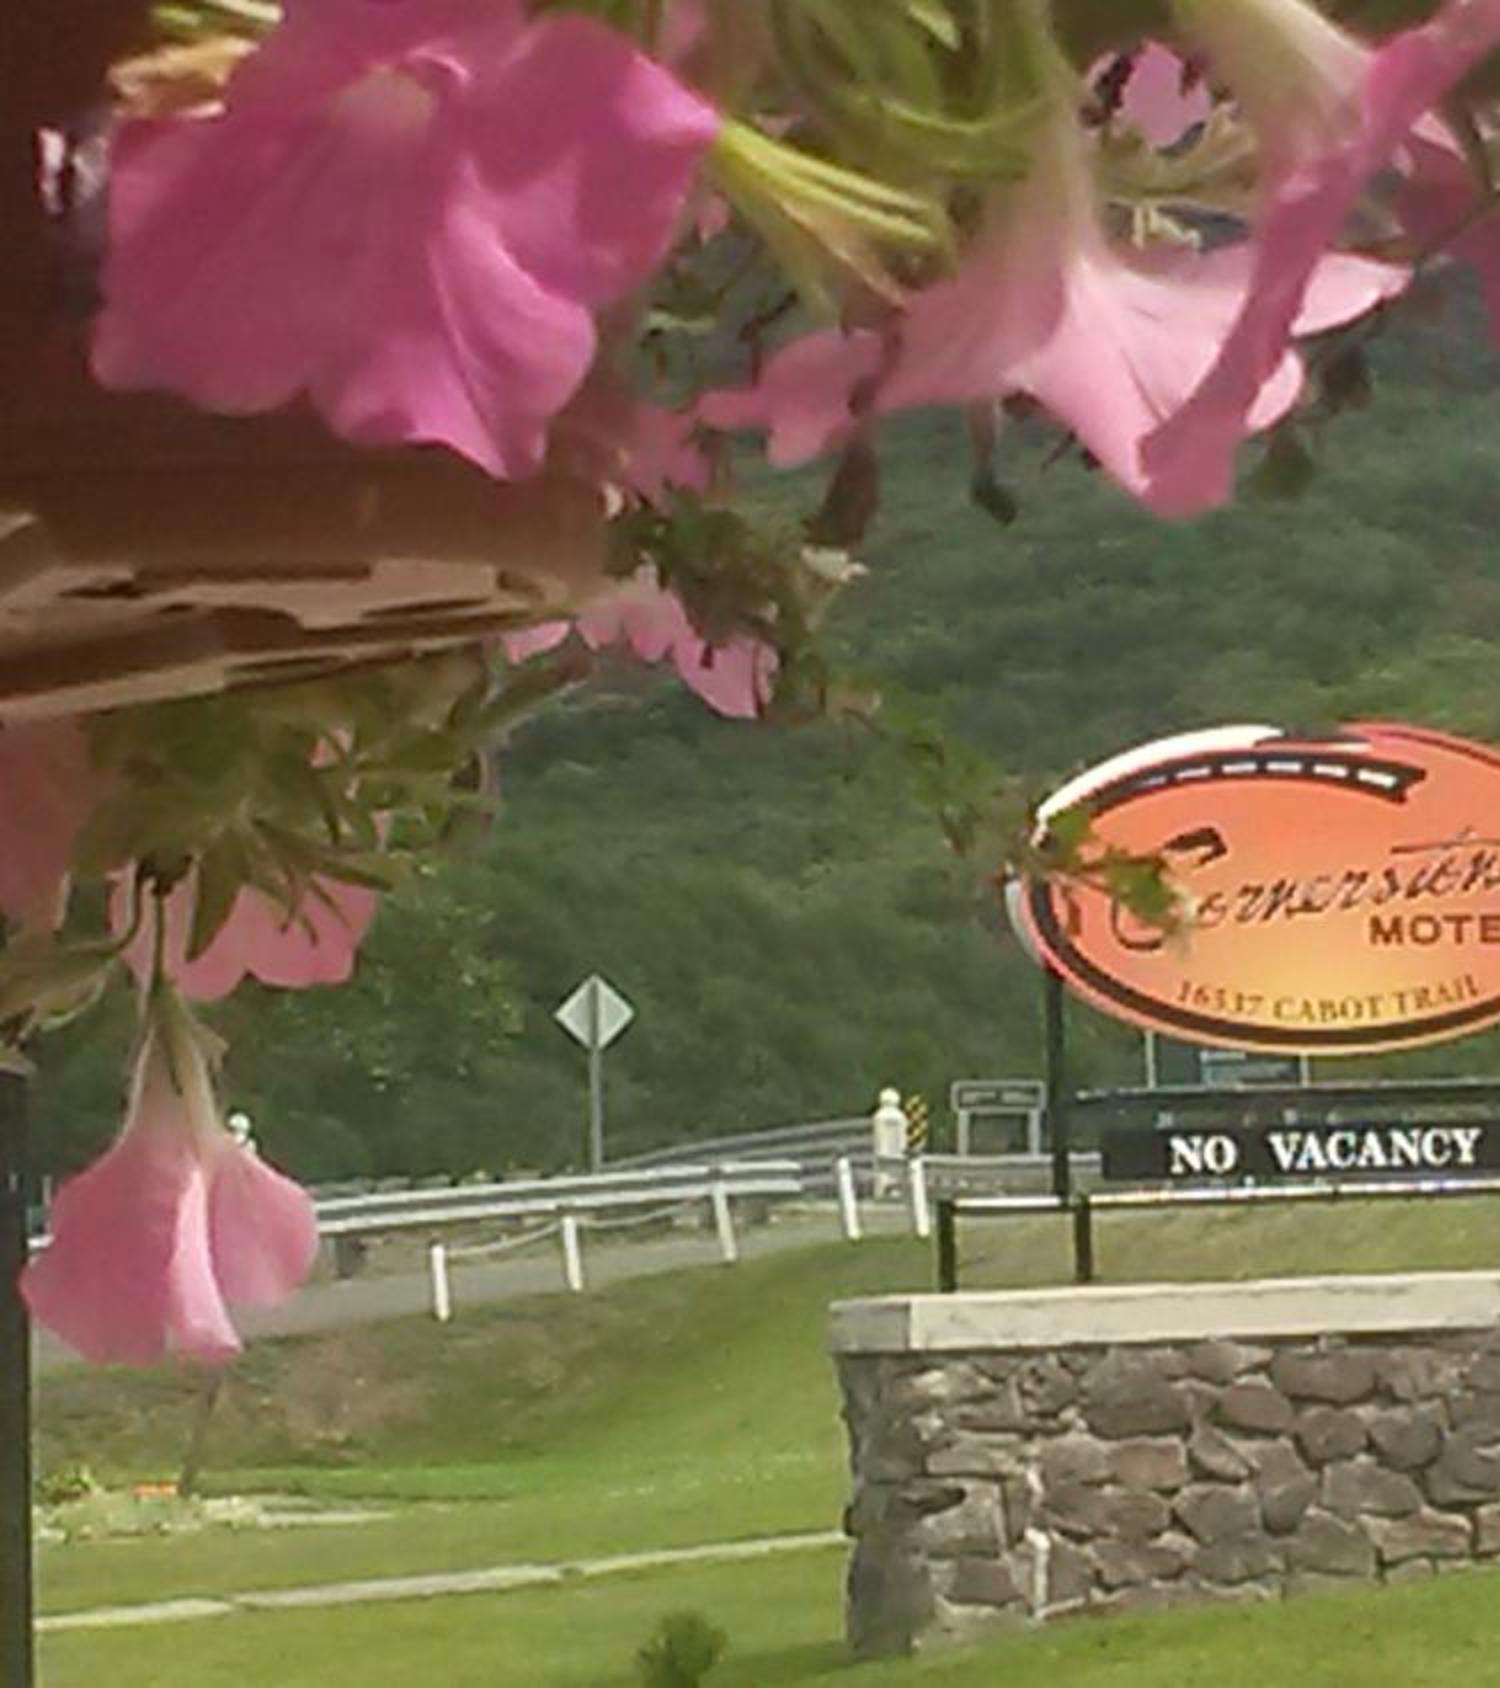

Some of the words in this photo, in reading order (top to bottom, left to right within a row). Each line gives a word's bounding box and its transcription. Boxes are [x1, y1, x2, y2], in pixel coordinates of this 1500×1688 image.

[1273, 993, 1386, 1022] CABOT
[1390, 974, 1480, 1014] TRAIL
[1169, 1135, 1238, 1174] NO
[1268, 1127, 1482, 1172] VACANCY
